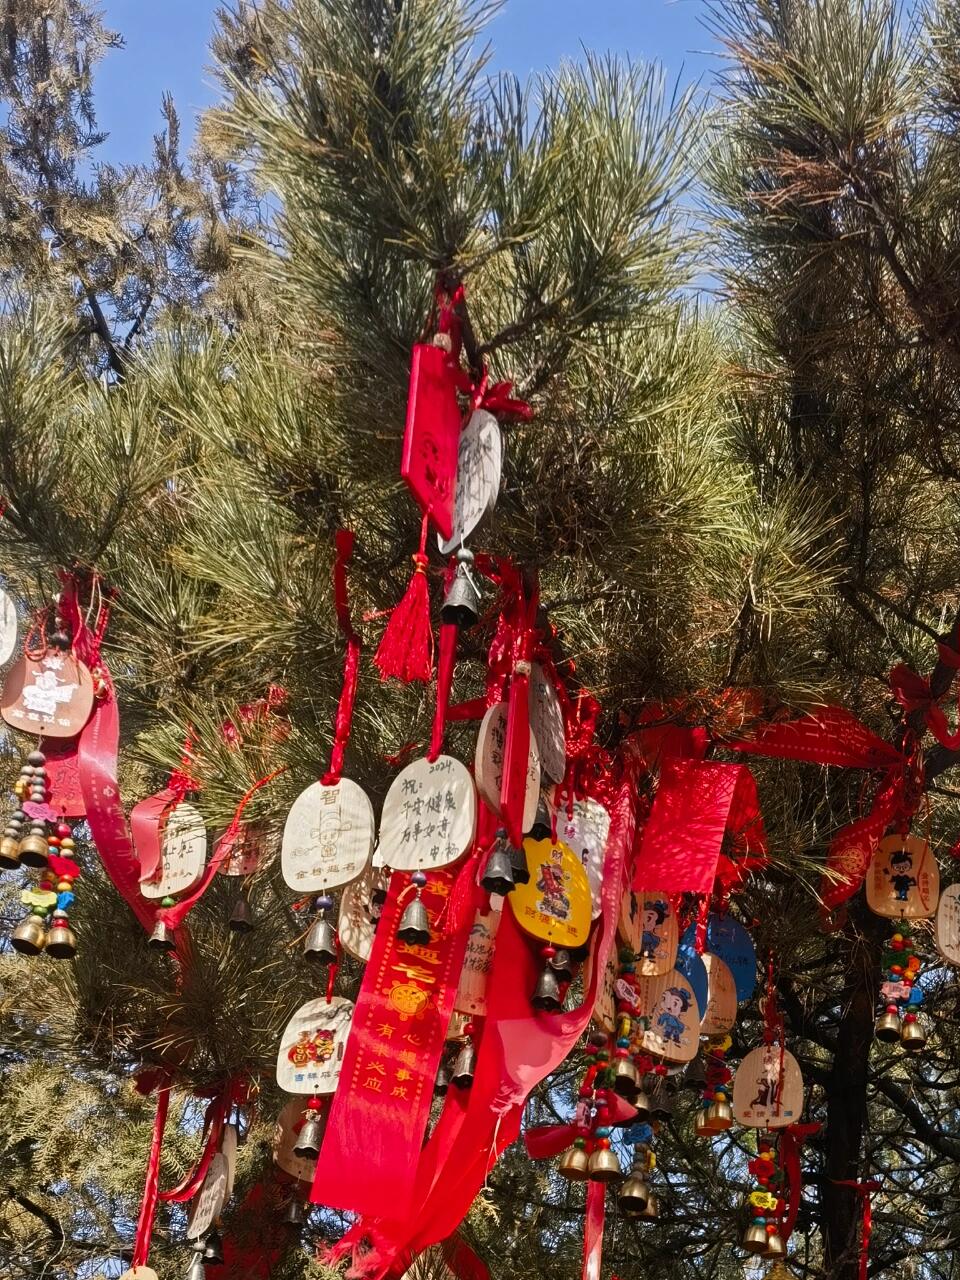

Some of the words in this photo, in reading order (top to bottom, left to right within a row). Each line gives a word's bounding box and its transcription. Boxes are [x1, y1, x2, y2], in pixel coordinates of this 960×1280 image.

[320, 789, 340, 805] 智
[401, 790, 456, 820] 平安健康
[400, 818, 451, 844] 万事如意
[295, 862, 356, 880] 金榜题名
[390, 1031, 423, 1101] 心想事成
